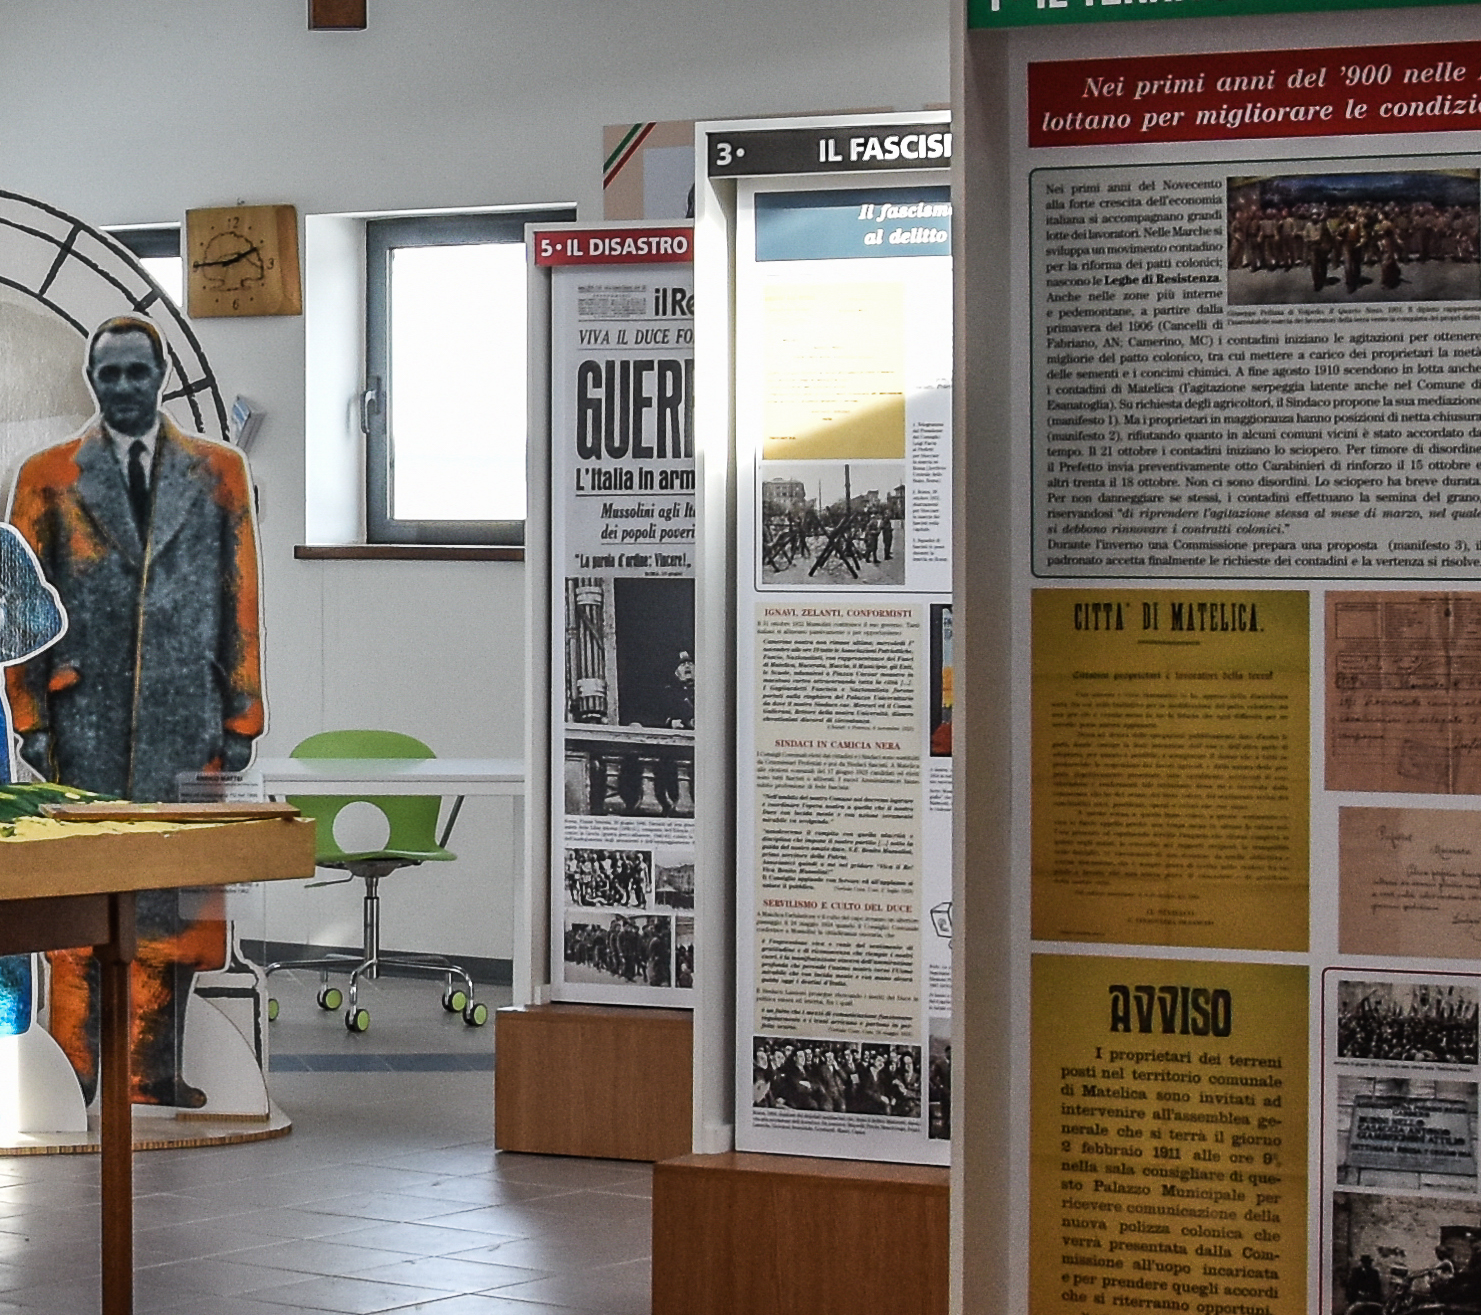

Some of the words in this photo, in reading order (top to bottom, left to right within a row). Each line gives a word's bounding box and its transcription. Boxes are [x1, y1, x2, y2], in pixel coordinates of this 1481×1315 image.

[1082, 76, 1124, 97] Nei
[1134, 73, 1204, 100] primi
[1216, 69, 1275, 92] anni
[1287, 67, 1326, 89] del
[1403, 61, 1466, 83] nelle
[1042, 112, 1131, 131] lottano
[1140, 111, 1185, 132] per
[1195, 102, 1333, 128] migliorare
[1345, 98, 1368, 119] le
[819, 138, 842, 162] IL
[858, 203, 874, 220] Il
[567, 238, 583, 256] IL
[589, 236, 687, 256] DISASTRO
[864, 229, 884, 245] al
[889, 227, 948, 244] delitto
[654, 288, 667, 316] il
[578, 329, 610, 345] VIVA
[616, 329, 628, 345] IL
[634, 328, 670, 345] DUCE
[576, 467, 634, 491] L'Italia
[638, 466, 654, 490] in
[600, 501, 655, 519] Mussolini
[657, 501, 680, 521] agli
[600, 523, 618, 539] dei
[621, 522, 656, 542] popoli
[659, 523, 695, 542] poveri
[764, 608, 798, 617] IGNAVI,
[801, 608, 843, 617] ZELANTI,
[846, 609, 911, 618] CONFORMISTI
[775, 739, 813, 748] SINDACI
[817, 740, 827, 748] IN
[830, 740, 871, 749] CAMICIA
[875, 741, 900, 750] NERA
[762, 899, 818, 909] SERVILISMO
[820, 901, 828, 910] E
[830, 902, 861, 911] CULTO
[864, 903, 883, 912] DEL
[886, 904, 912, 913] DUCE
[1109, 984, 1231, 1037] AVVISO
[1094, 1046, 1102, 1060] I
[1109, 1049, 1192, 1064] proprietari
[1198, 1052, 1221, 1065] dei
[1228, 1054, 1283, 1069] terreni
